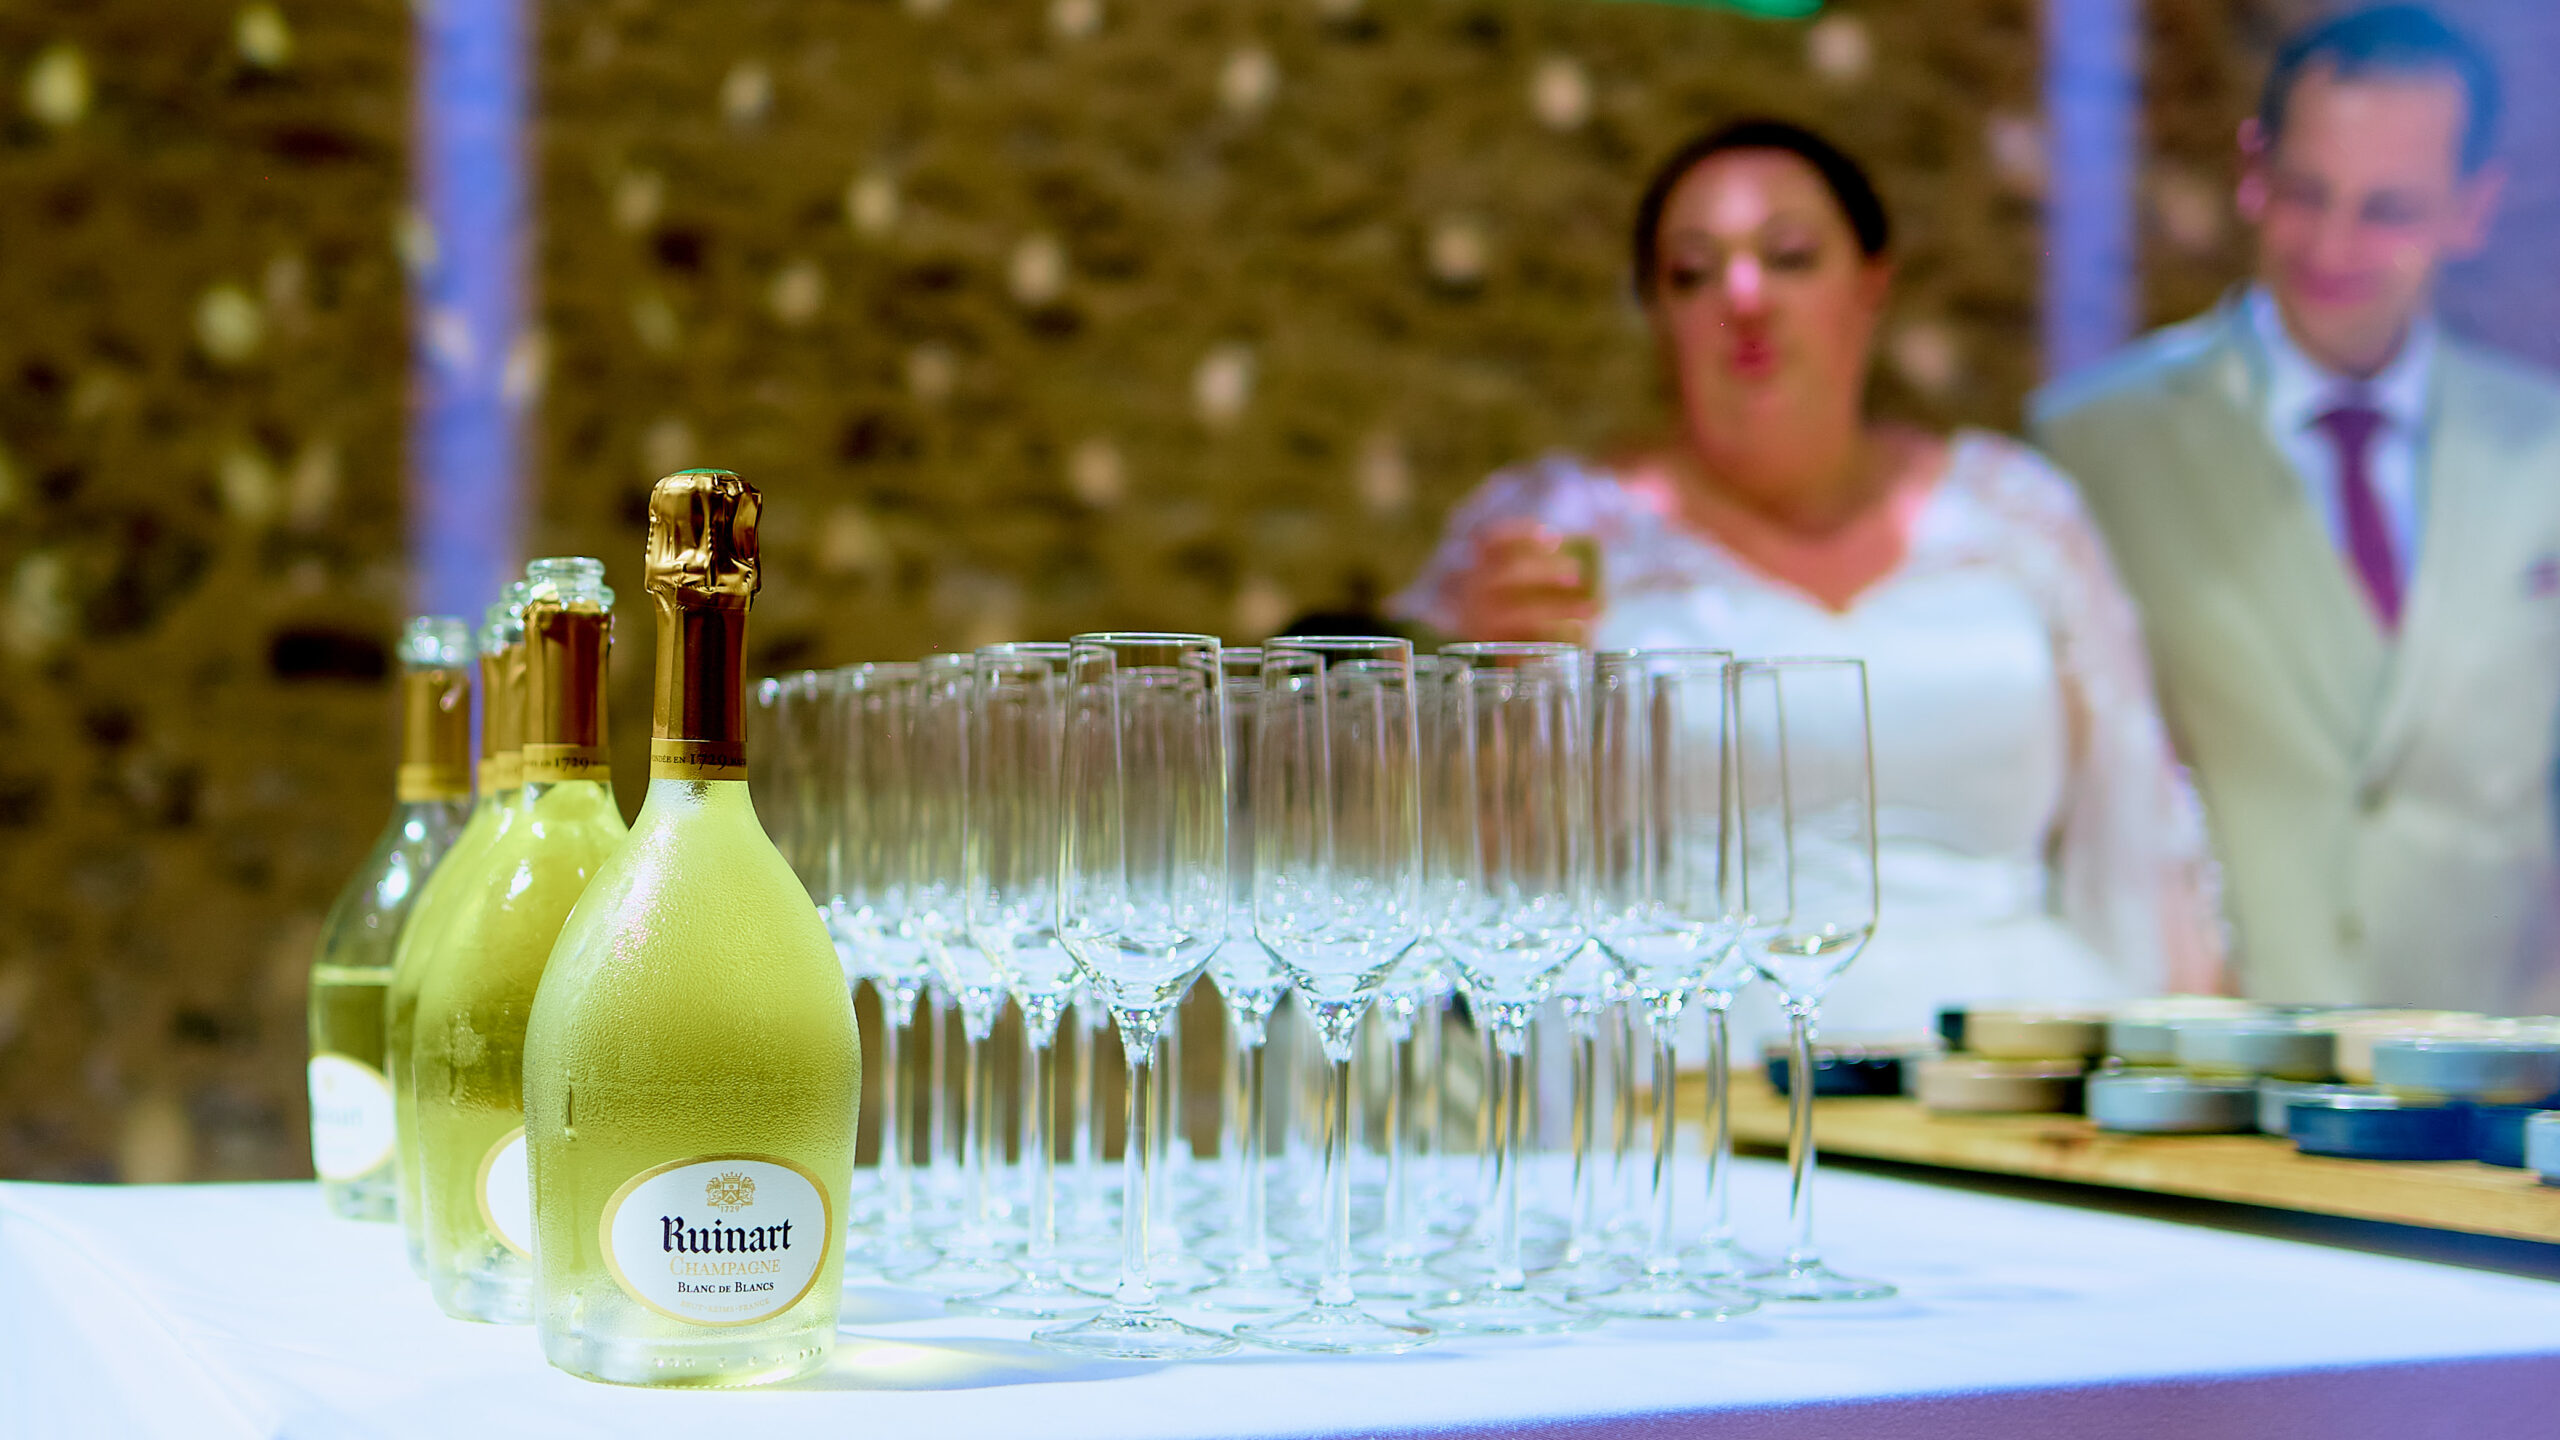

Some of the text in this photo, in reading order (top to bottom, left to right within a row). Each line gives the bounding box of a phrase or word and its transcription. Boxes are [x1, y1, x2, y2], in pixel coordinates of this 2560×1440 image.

[690, 753, 727, 770] 1729
[720, 1204, 740, 1213] 1729
[660, 1215, 793, 1254] Ruinart
[670, 1256, 781, 1276] CHAMPAGNE
[678, 1281, 715, 1293] BLANC
[735, 1281, 774, 1293] BLANCS
